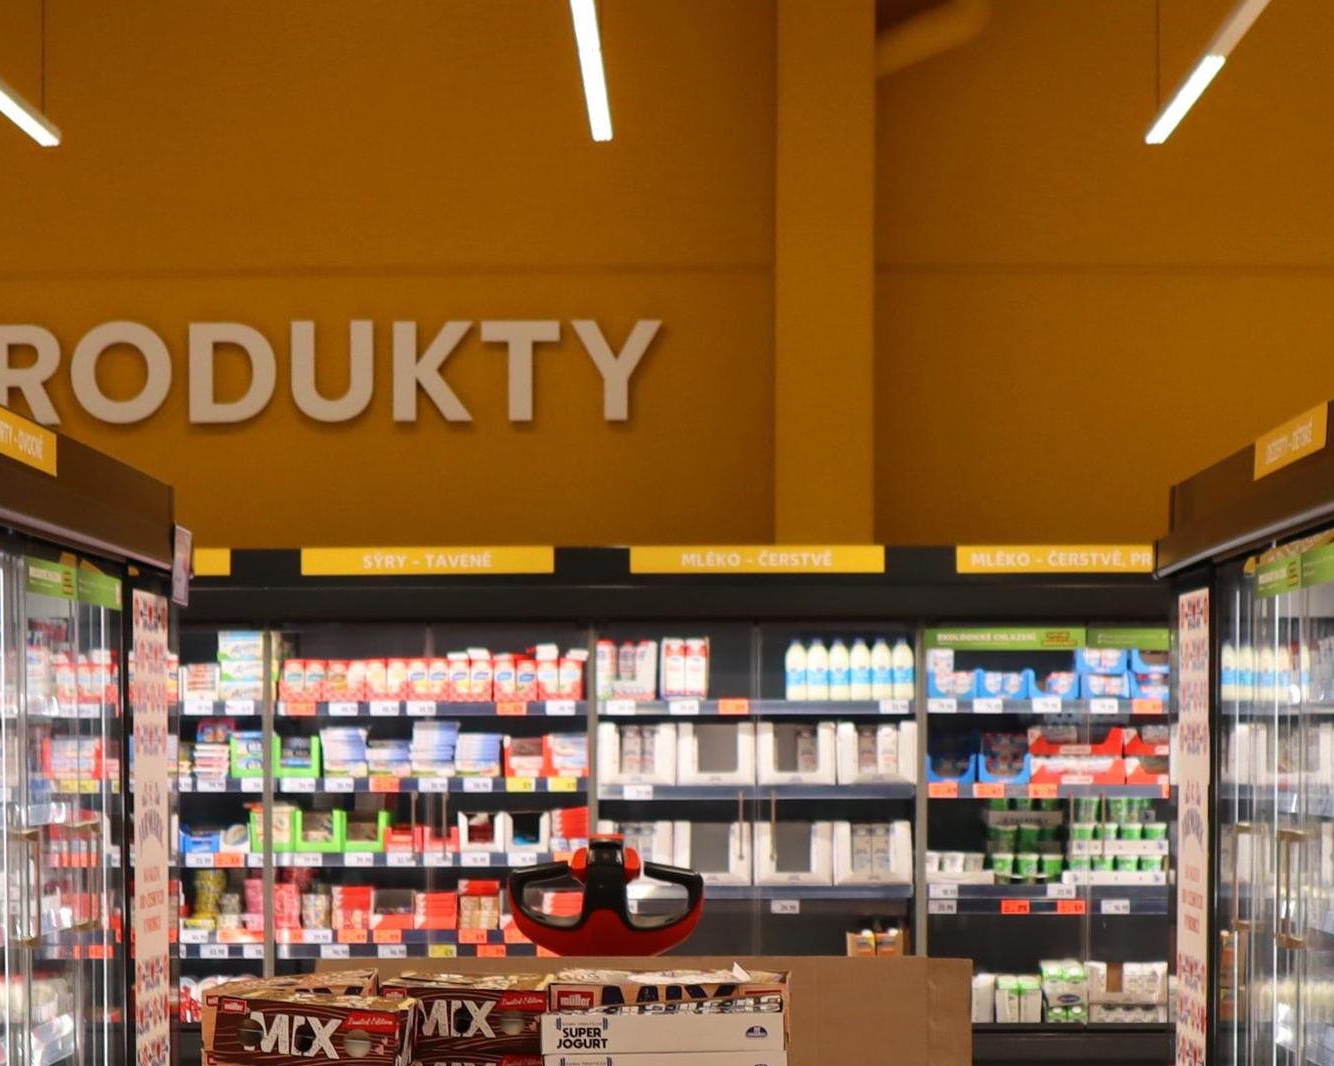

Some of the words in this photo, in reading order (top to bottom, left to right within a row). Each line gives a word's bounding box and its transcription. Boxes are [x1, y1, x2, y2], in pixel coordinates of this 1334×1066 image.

[18, 423, 44, 459] OVOCNÉ
[362, 554, 406, 569] SÝRY
[425, 553, 492, 569] TAVENÉ
[681, 552, 740, 568] MLÉKO
[758, 550, 833, 568] ČERSTVÉ
[971, 551, 1030, 568] MLÉKO
[1047, 549, 1125, 569] ČERSTVÉ,
[560, 993, 591, 1007] müller
[417, 998, 497, 1038] MIX
[241, 1010, 343, 1060] MIX
[563, 1027, 602, 1039] SUPER
[556, 1038, 608, 1050] JOGURT
